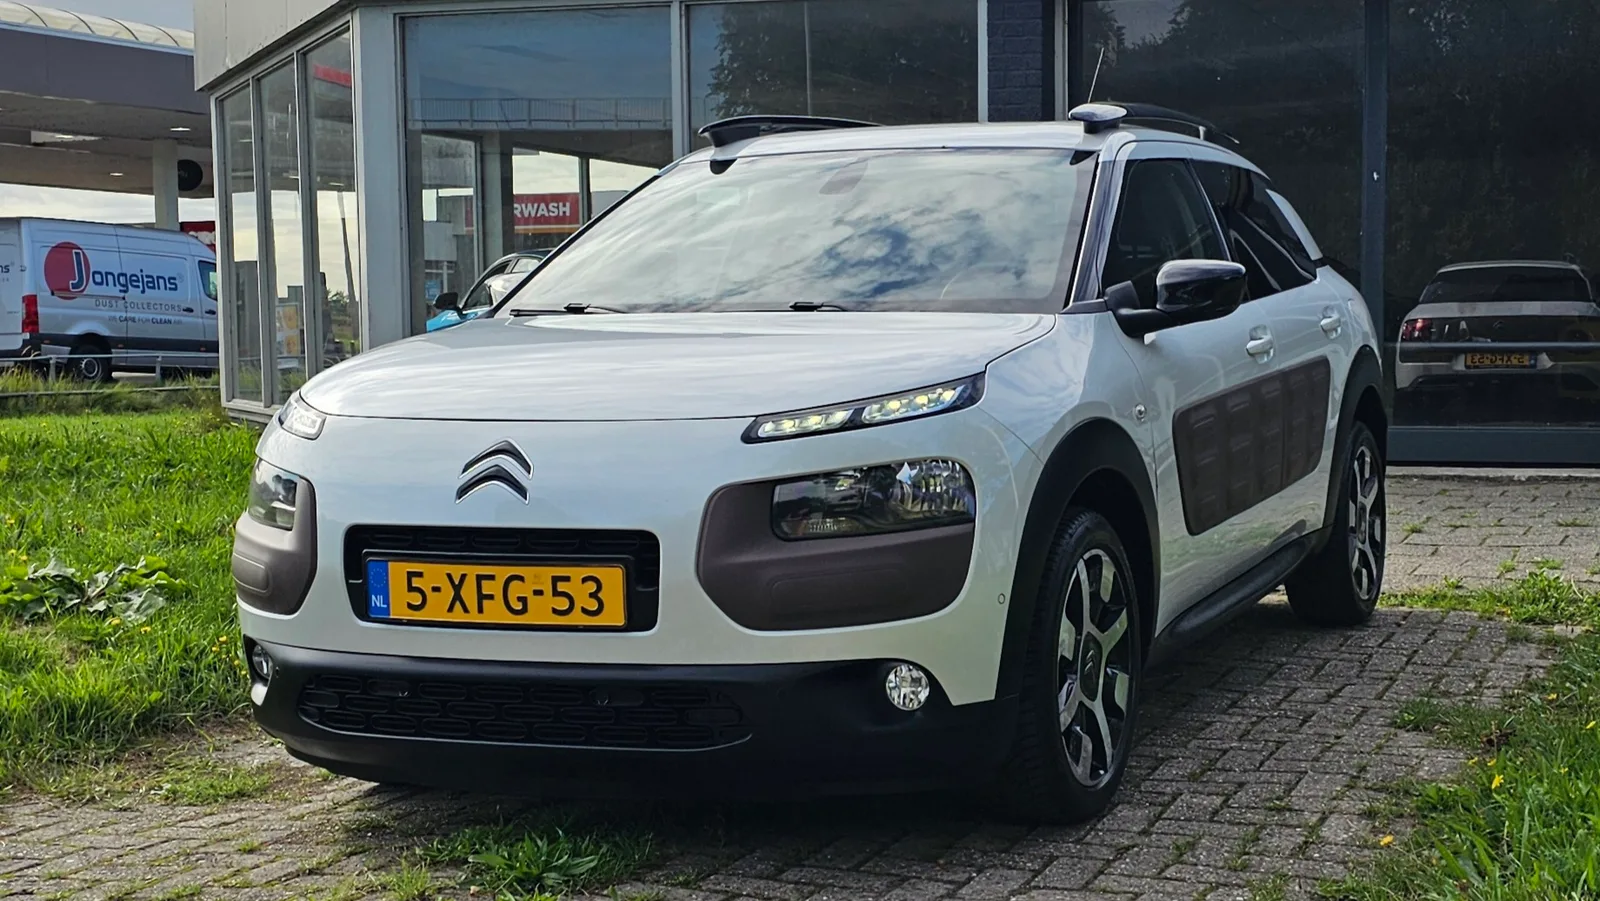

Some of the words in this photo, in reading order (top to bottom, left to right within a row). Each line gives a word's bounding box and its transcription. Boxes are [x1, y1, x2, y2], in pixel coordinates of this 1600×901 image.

[70, 249, 178, 294] Jongejans
[94, 299, 119, 309] DUST
[123, 300, 182, 313] COLLECTORS
[118, 315, 137, 324] CARE
[151, 317, 173, 325] CLEAN
[406, 571, 604, 616] 5-XFG-53
[371, 594, 387, 608] NL
